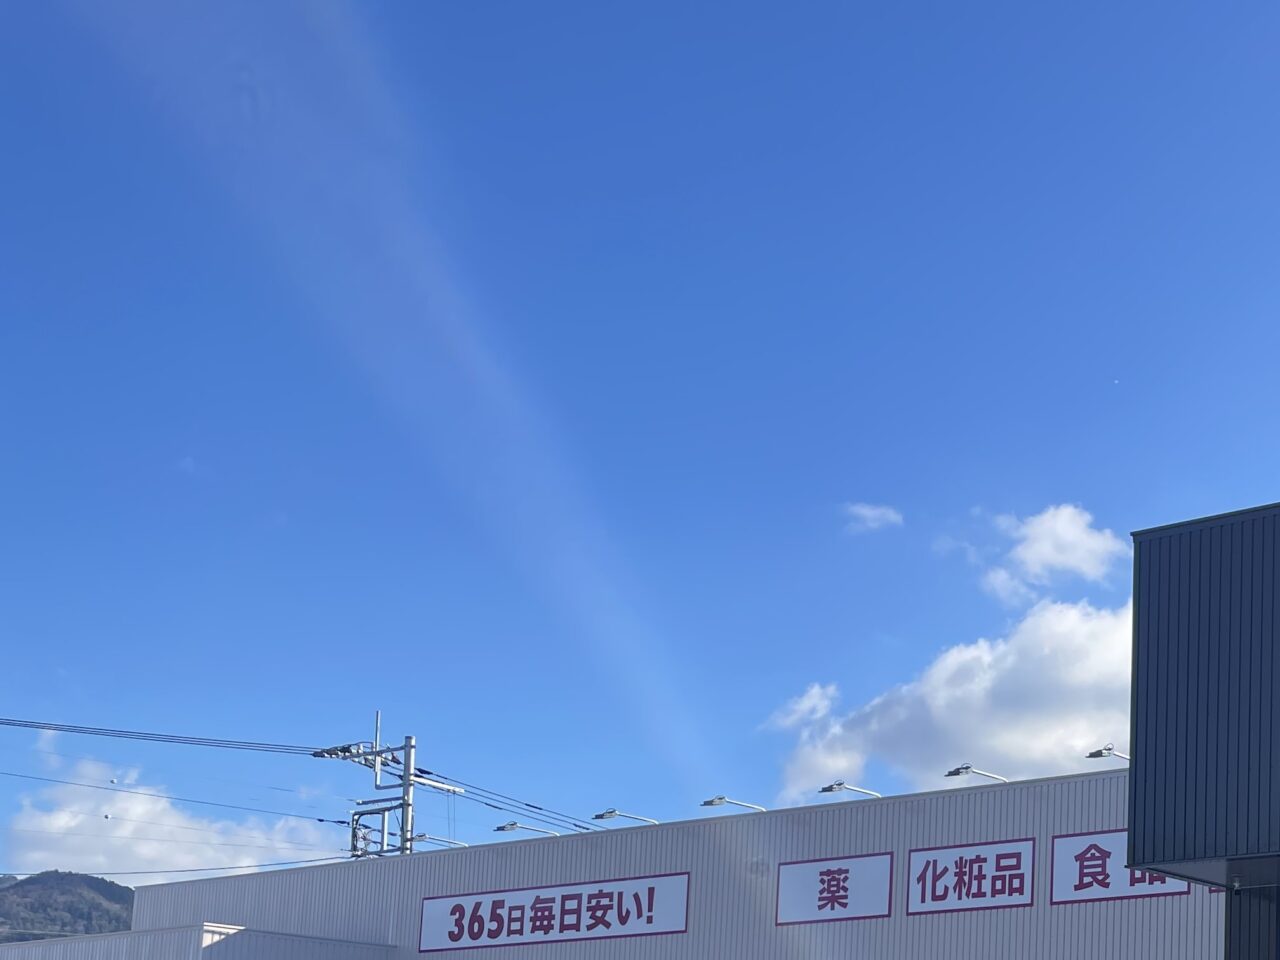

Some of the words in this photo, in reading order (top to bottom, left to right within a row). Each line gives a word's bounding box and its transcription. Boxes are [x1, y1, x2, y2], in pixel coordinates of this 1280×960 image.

[817, 868, 850, 911] 薬
[916, 852, 1026, 904] 化粧品
